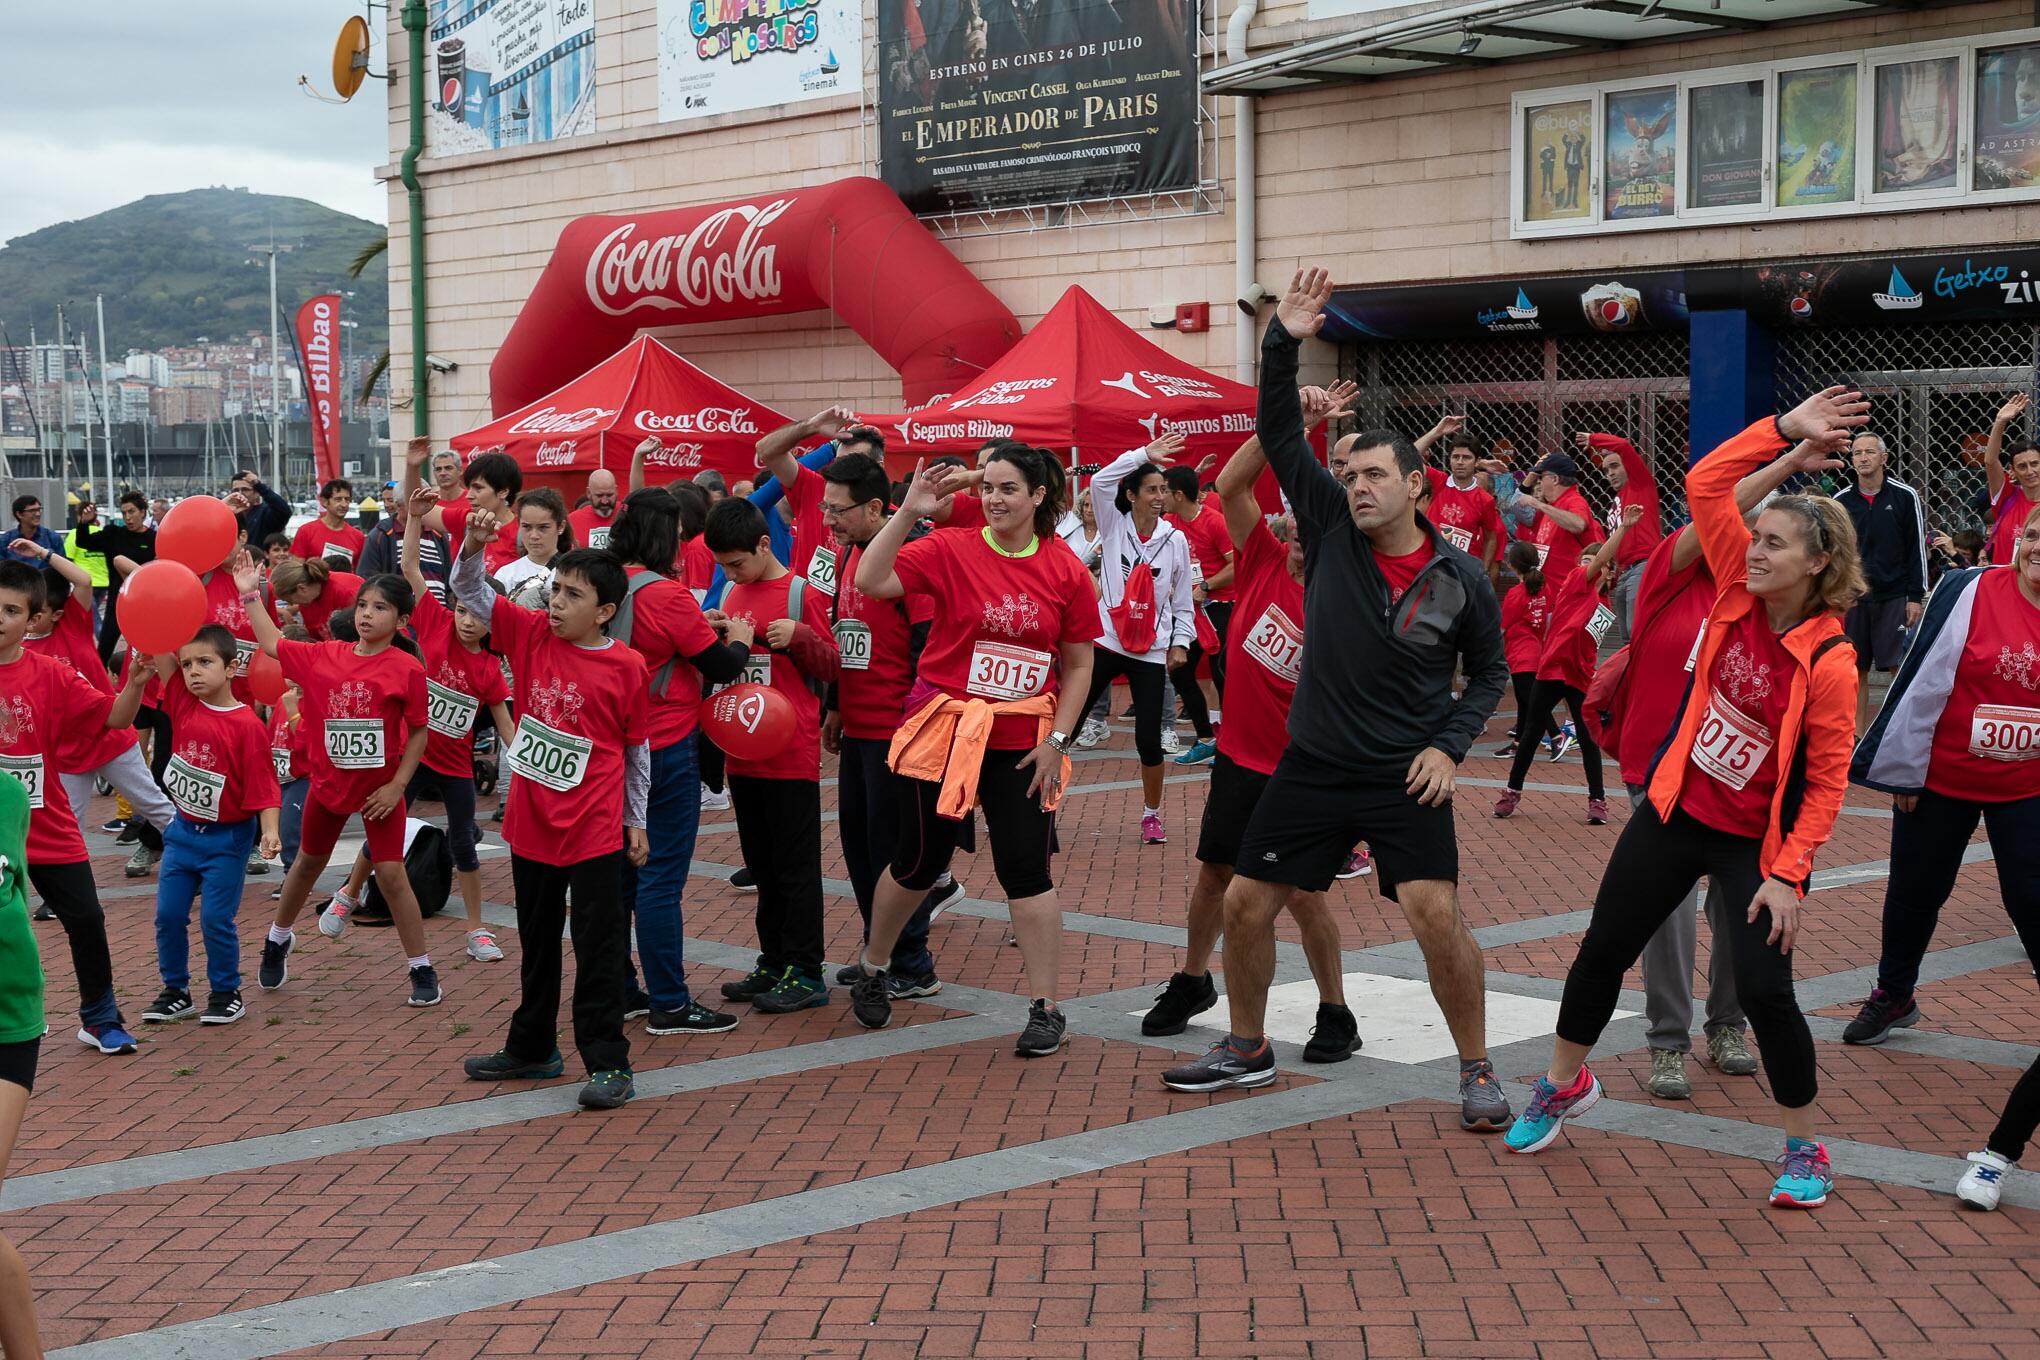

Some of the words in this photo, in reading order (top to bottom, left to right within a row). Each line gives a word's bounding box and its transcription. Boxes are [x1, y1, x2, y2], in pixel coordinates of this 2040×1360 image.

[698, 28, 731, 58] CON
[731, 13, 818, 63] NOSOTROS
[929, 61, 987, 80] ESTRENO
[992, 57, 1009, 70] EN
[1014, 50, 1054, 67] CINES
[1059, 48, 1073, 60] 26
[1079, 43, 1096, 57] DE
[1102, 36, 1142, 56] JULIO
[803, 76, 838, 91] zinemak
[902, 131, 914, 142] EL
[916, 107, 1060, 150] EMPERADOR
[1065, 108, 1079, 120] DE
[1083, 92, 1158, 129] PARIS
[932, 164, 955, 176] BASADA
[955, 163, 965, 173] EN
[973, 160, 988, 171] VIDA
[988, 159, 1000, 169] DEL
[1000, 157, 1026, 168] FAMOSO
[1026, 152, 1072, 166] CRIMINÓLOGO
[1072, 145, 1109, 160] FRANÇOIS
[1110, 142, 1141, 156] VIDOCQ
[1980, 142, 1995, 150] AD
[1702, 172, 1721, 183] DON
[586, 197, 798, 315] Coca-Cola
[1935, 259, 2008, 298] Getxo
[2000, 270, 2040, 304] zi
[1487, 319, 1542, 332] zinemak
[634, 407, 759, 434] Coca-Cola
[912, 421, 965, 443] Seguros
[968, 419, 1014, 438] Bilbao
[1160, 418, 1220, 439] Seguros
[536, 440, 577, 466] Coca-Cola
[1257, 623, 1303, 672] 301
[977, 656, 1041, 691] 3015
[329, 732, 377, 756] 2053
[516, 733, 580, 779] 2006
[167, 769, 214, 808] 2033
